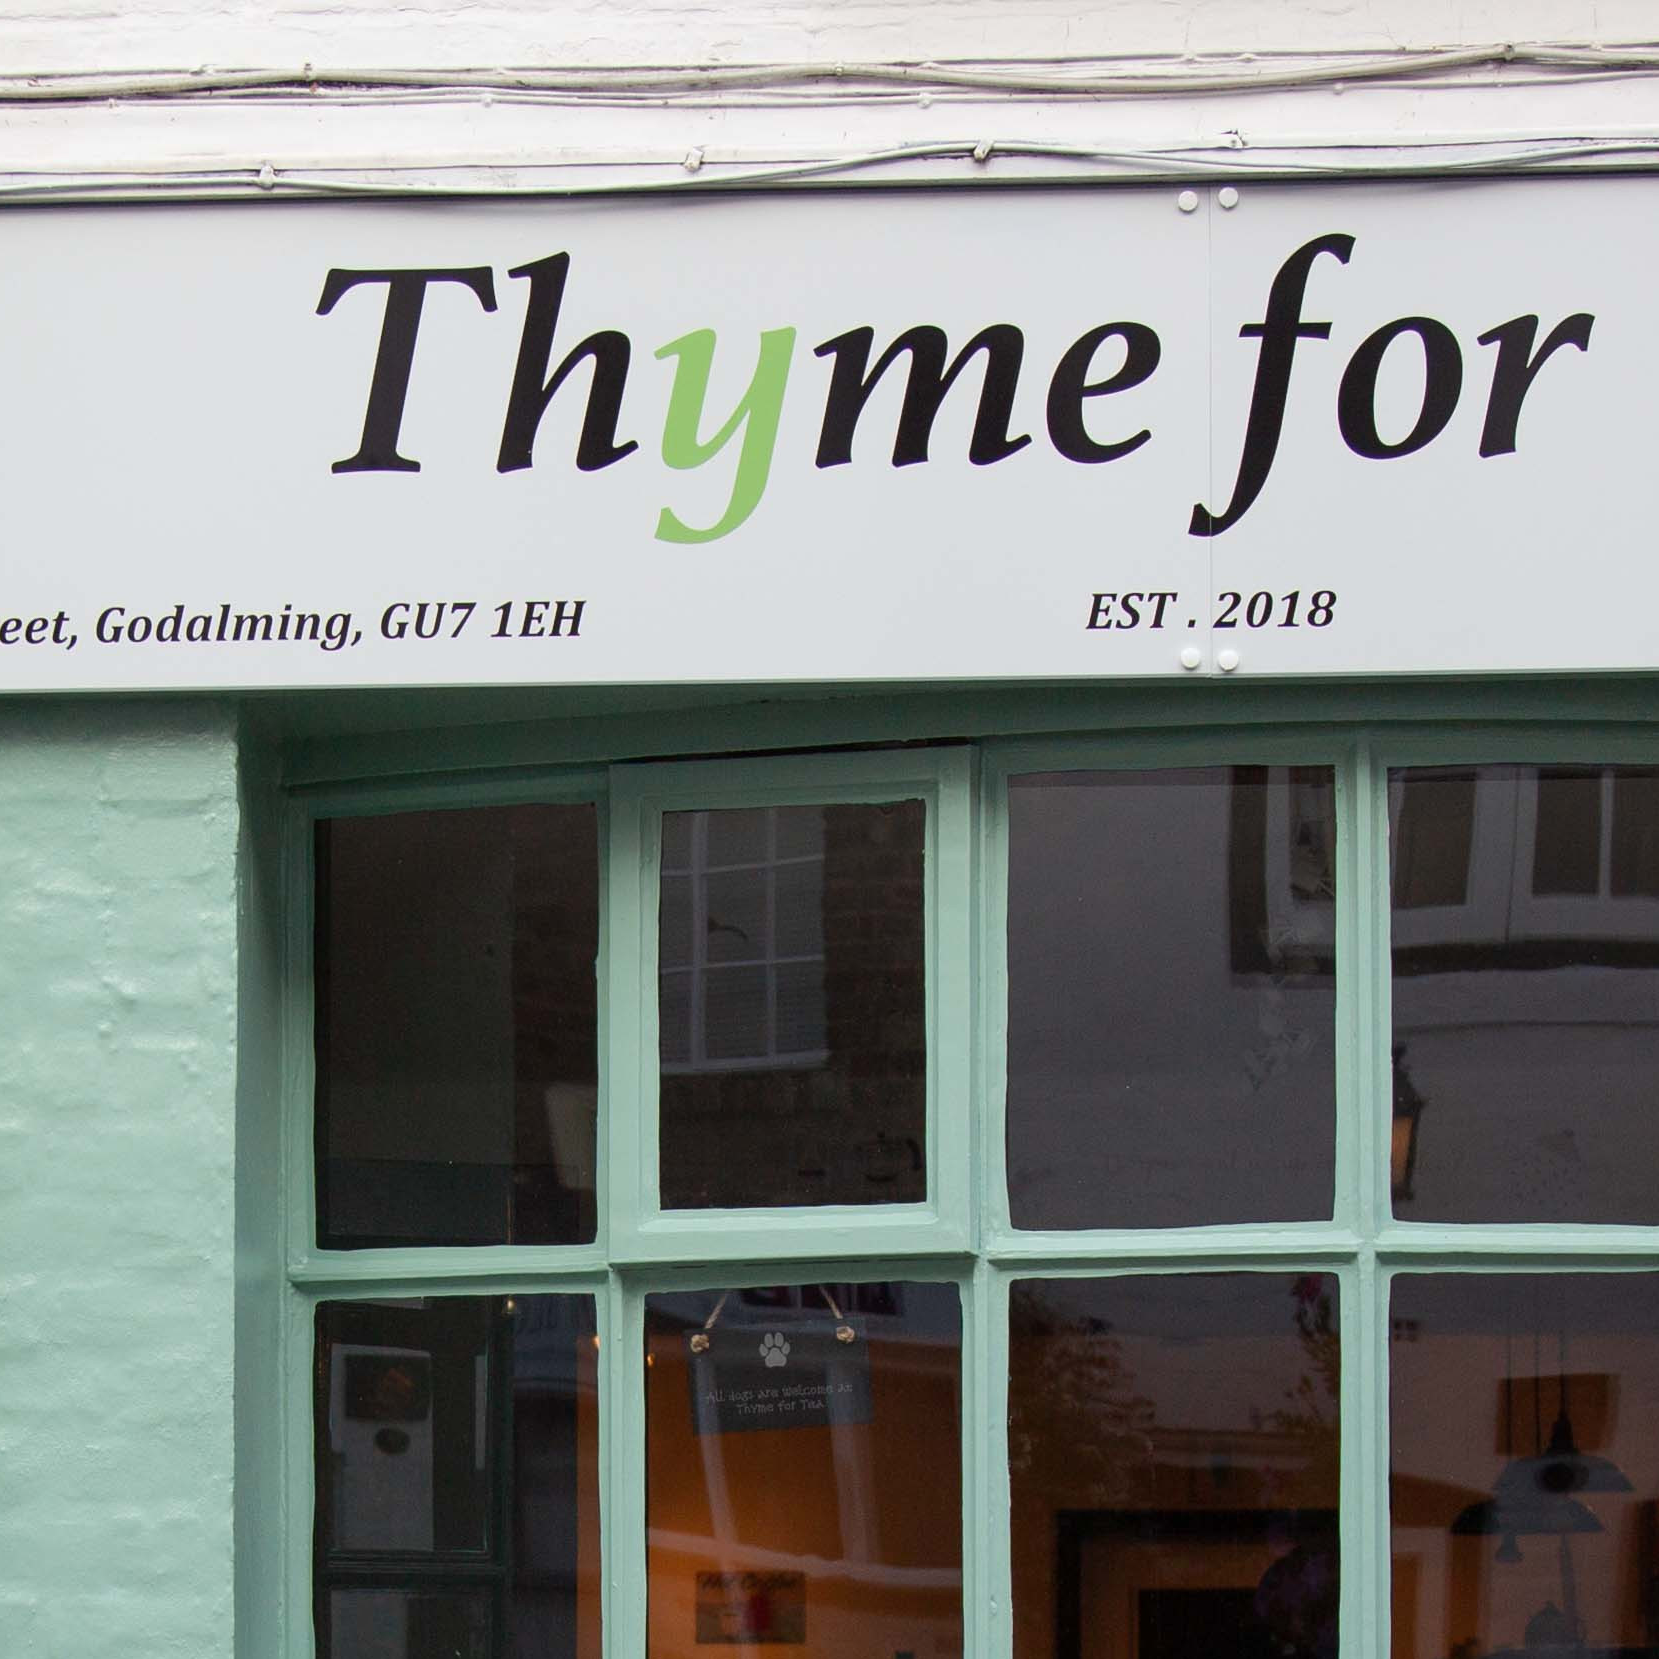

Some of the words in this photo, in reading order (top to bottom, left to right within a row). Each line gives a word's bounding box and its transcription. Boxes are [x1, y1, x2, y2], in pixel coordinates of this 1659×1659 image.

[314, 250, 1163, 545] Thyme
[1187, 233, 1597, 539] for
[96, 603, 362, 652] Godalming,
[380, 602, 477, 640] GU7
[490, 600, 586, 638] 1EH
[1085, 591, 1197, 630] EST.
[1212, 590, 1338, 629] 2018
